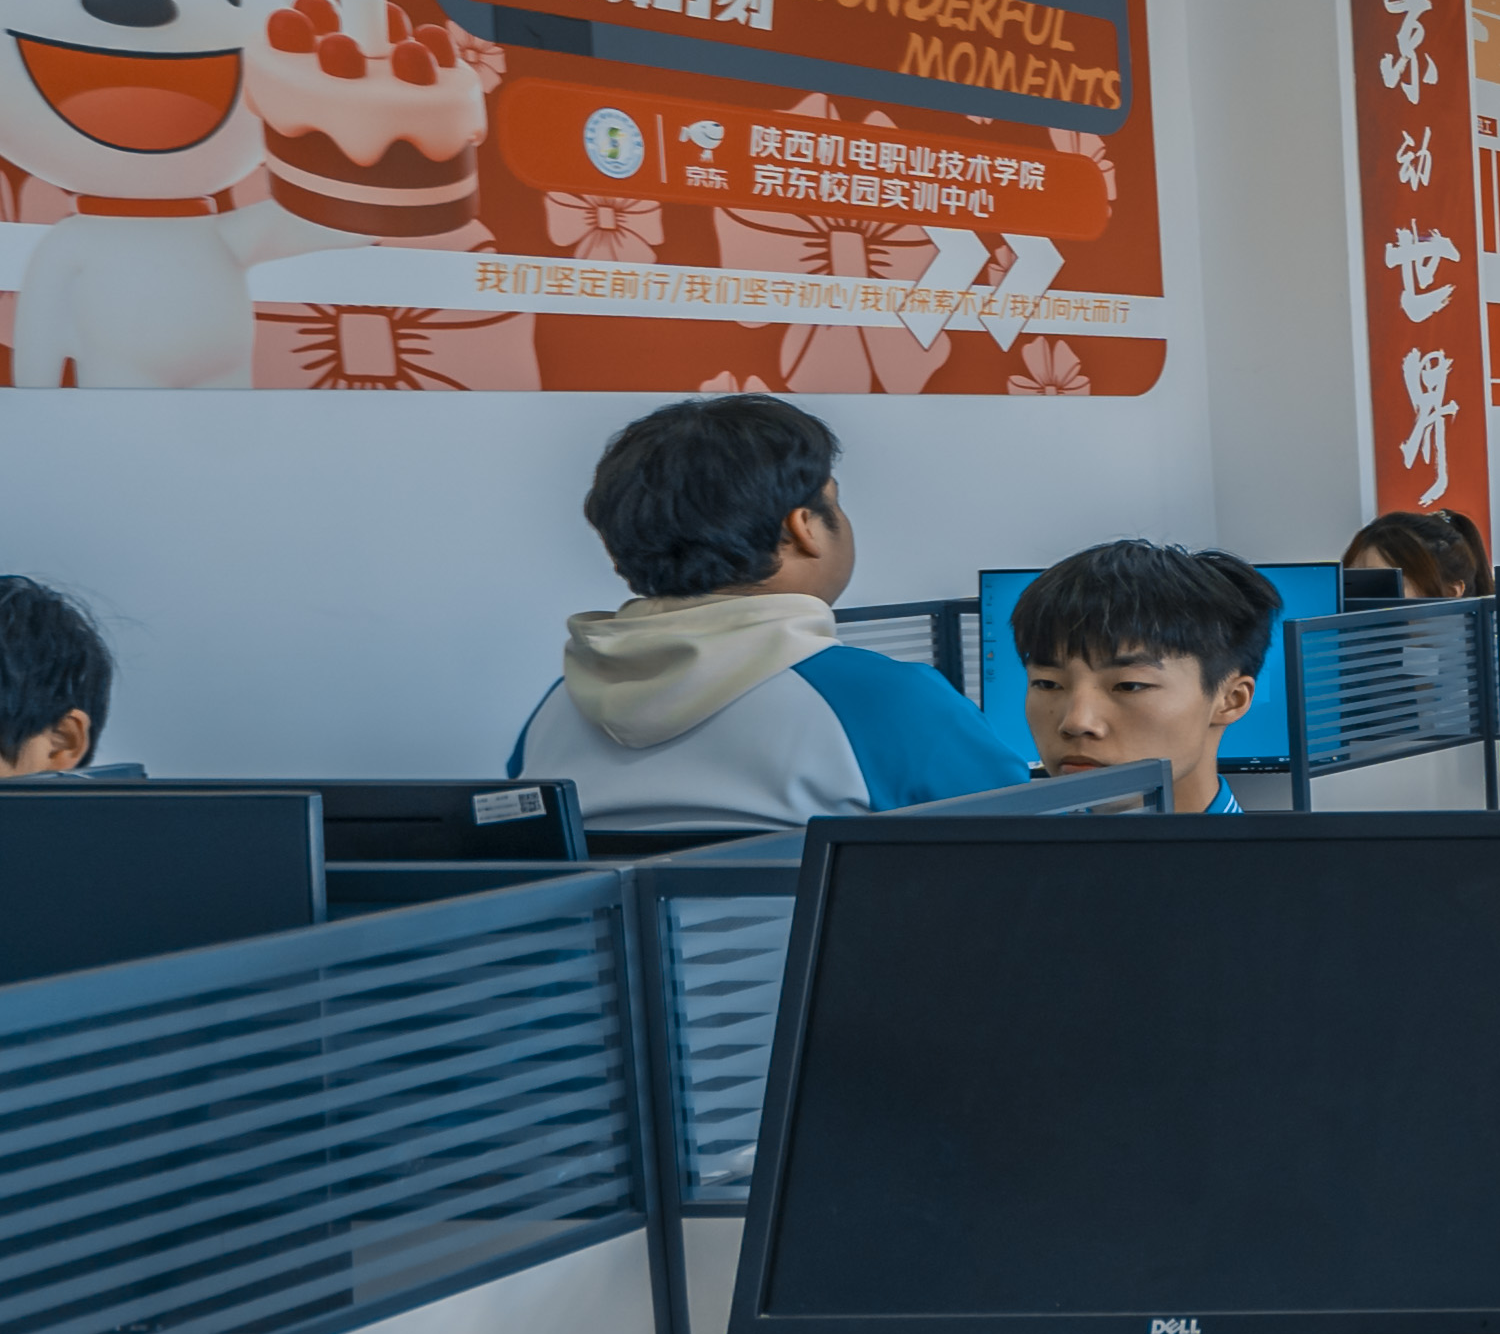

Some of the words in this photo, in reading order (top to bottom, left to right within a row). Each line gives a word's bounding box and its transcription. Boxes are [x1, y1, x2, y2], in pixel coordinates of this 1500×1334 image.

[899, 32, 1122, 111] MOMENTS
[685, 165, 730, 191] 京东
[749, 123, 1047, 193] 陕西机电职业技术学院
[752, 163, 995, 221] 京东校园实训中心
